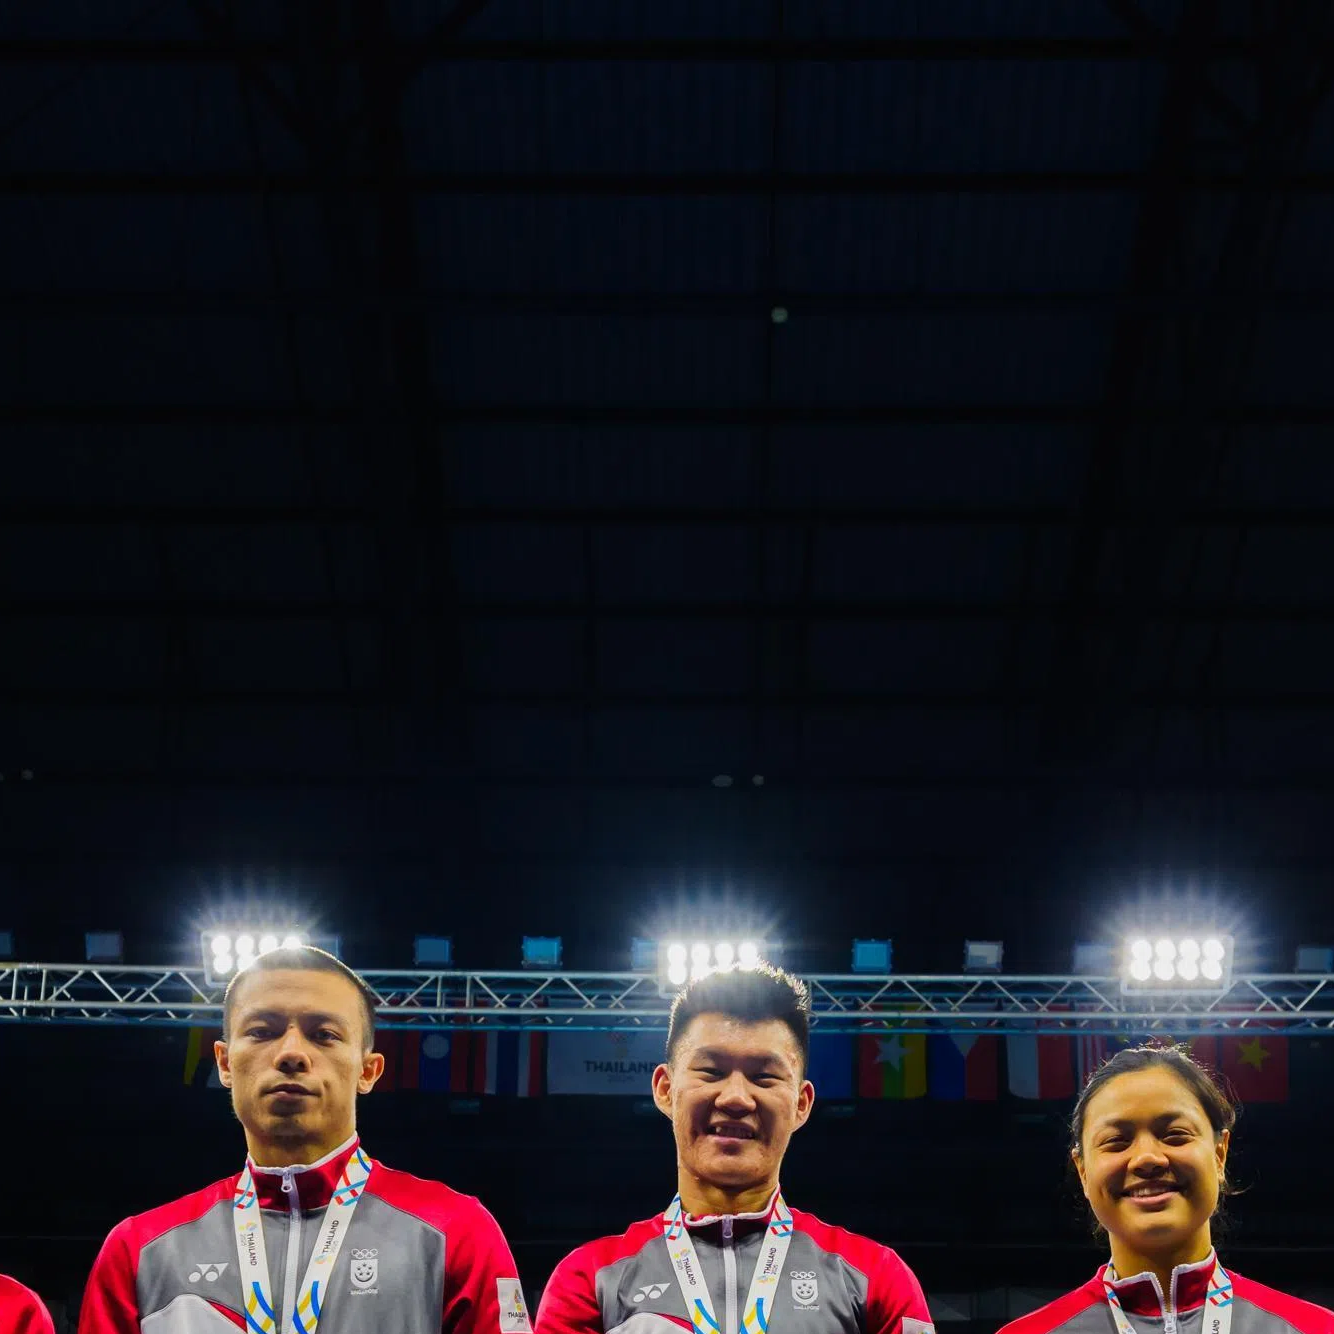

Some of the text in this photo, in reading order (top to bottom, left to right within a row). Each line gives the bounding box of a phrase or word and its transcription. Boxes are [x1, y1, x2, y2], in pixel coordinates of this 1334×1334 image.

[246, 1232, 258, 1266] THAILAND
[322, 1219, 340, 1253] THAILAND
[682, 1257, 697, 1286] THAILAND
[763, 1247, 777, 1275] THAILAND
